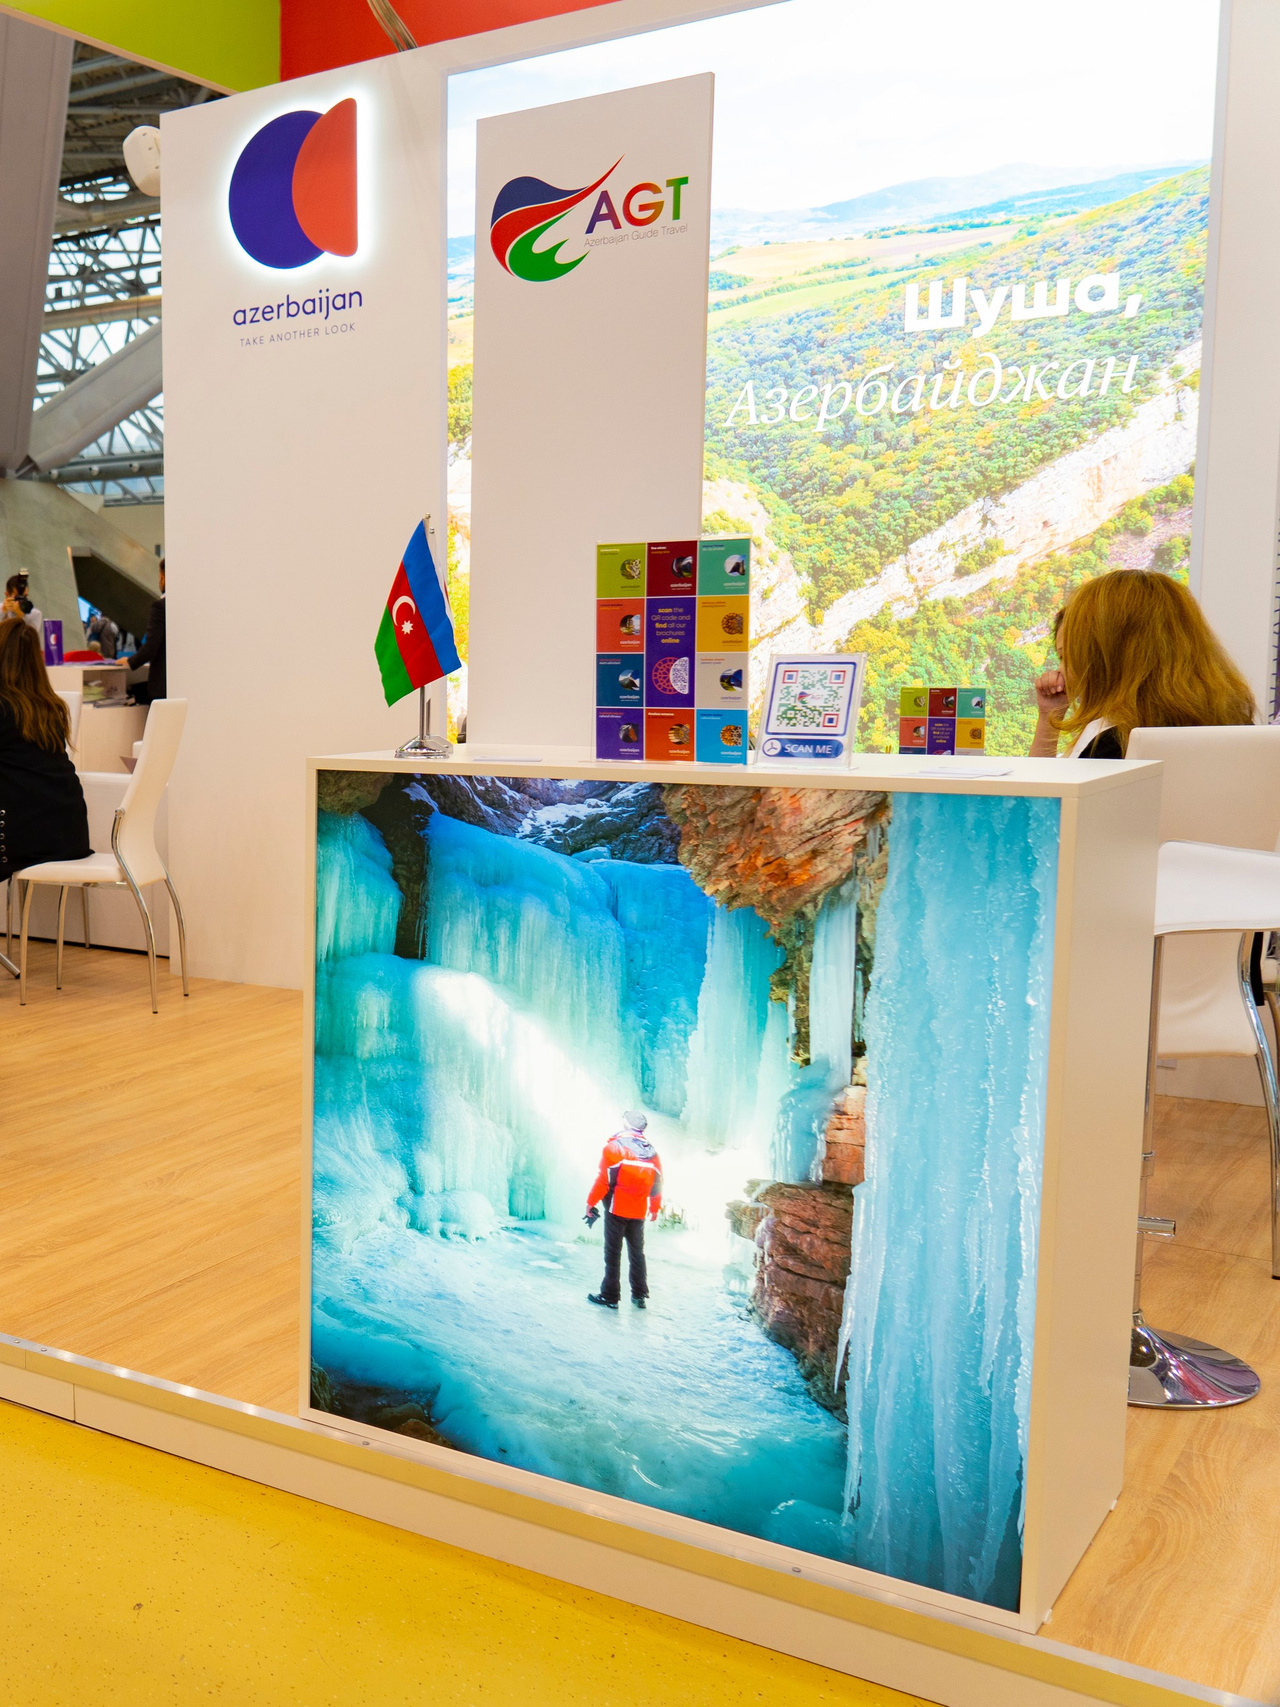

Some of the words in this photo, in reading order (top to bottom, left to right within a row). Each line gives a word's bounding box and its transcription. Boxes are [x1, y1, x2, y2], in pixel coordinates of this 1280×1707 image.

[584, 175, 689, 235] AGT
[583, 233, 629, 248] Azerbaijan
[631, 229, 659, 241] Guide
[661, 223, 688, 236] Travel
[232, 287, 363, 326] azerbaijan
[904, 272, 1143, 339] Шуша,
[239, 335, 265, 348] TAKE
[269, 327, 321, 344] ANOTHER
[324, 322, 356, 336] LOOK
[722, 352, 1140, 433] Азербайджан
[784, 743, 814, 753] SCAN
[815, 744, 833, 754] ME
